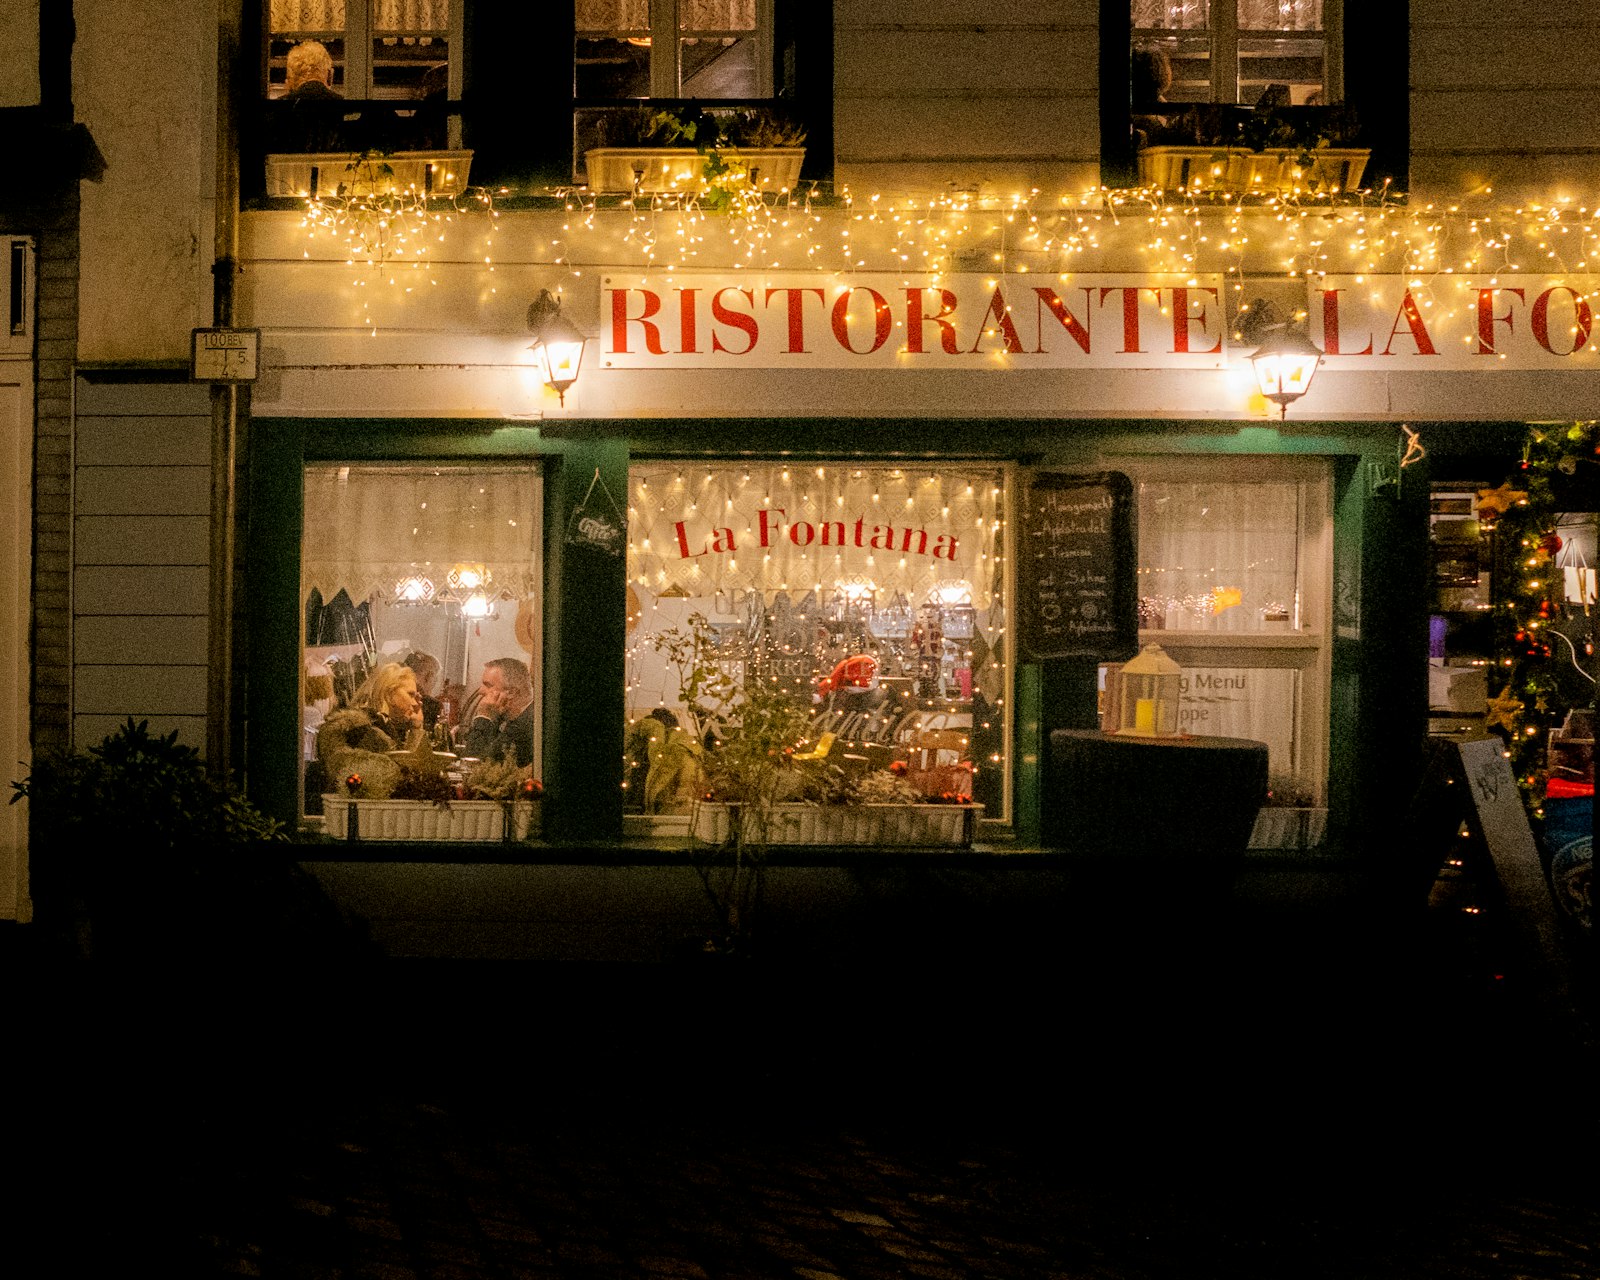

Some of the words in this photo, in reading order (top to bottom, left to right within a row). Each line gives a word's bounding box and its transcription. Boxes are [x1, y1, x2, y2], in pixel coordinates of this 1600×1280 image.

[604, 286, 1222, 355] RISTORANTE
[1314, 286, 1442, 356] LA
[1469, 285, 1600, 357] FO
[671, 519, 738, 560] La
[755, 508, 959, 562] Fontana
[1195, 674, 1246, 690] Menü
